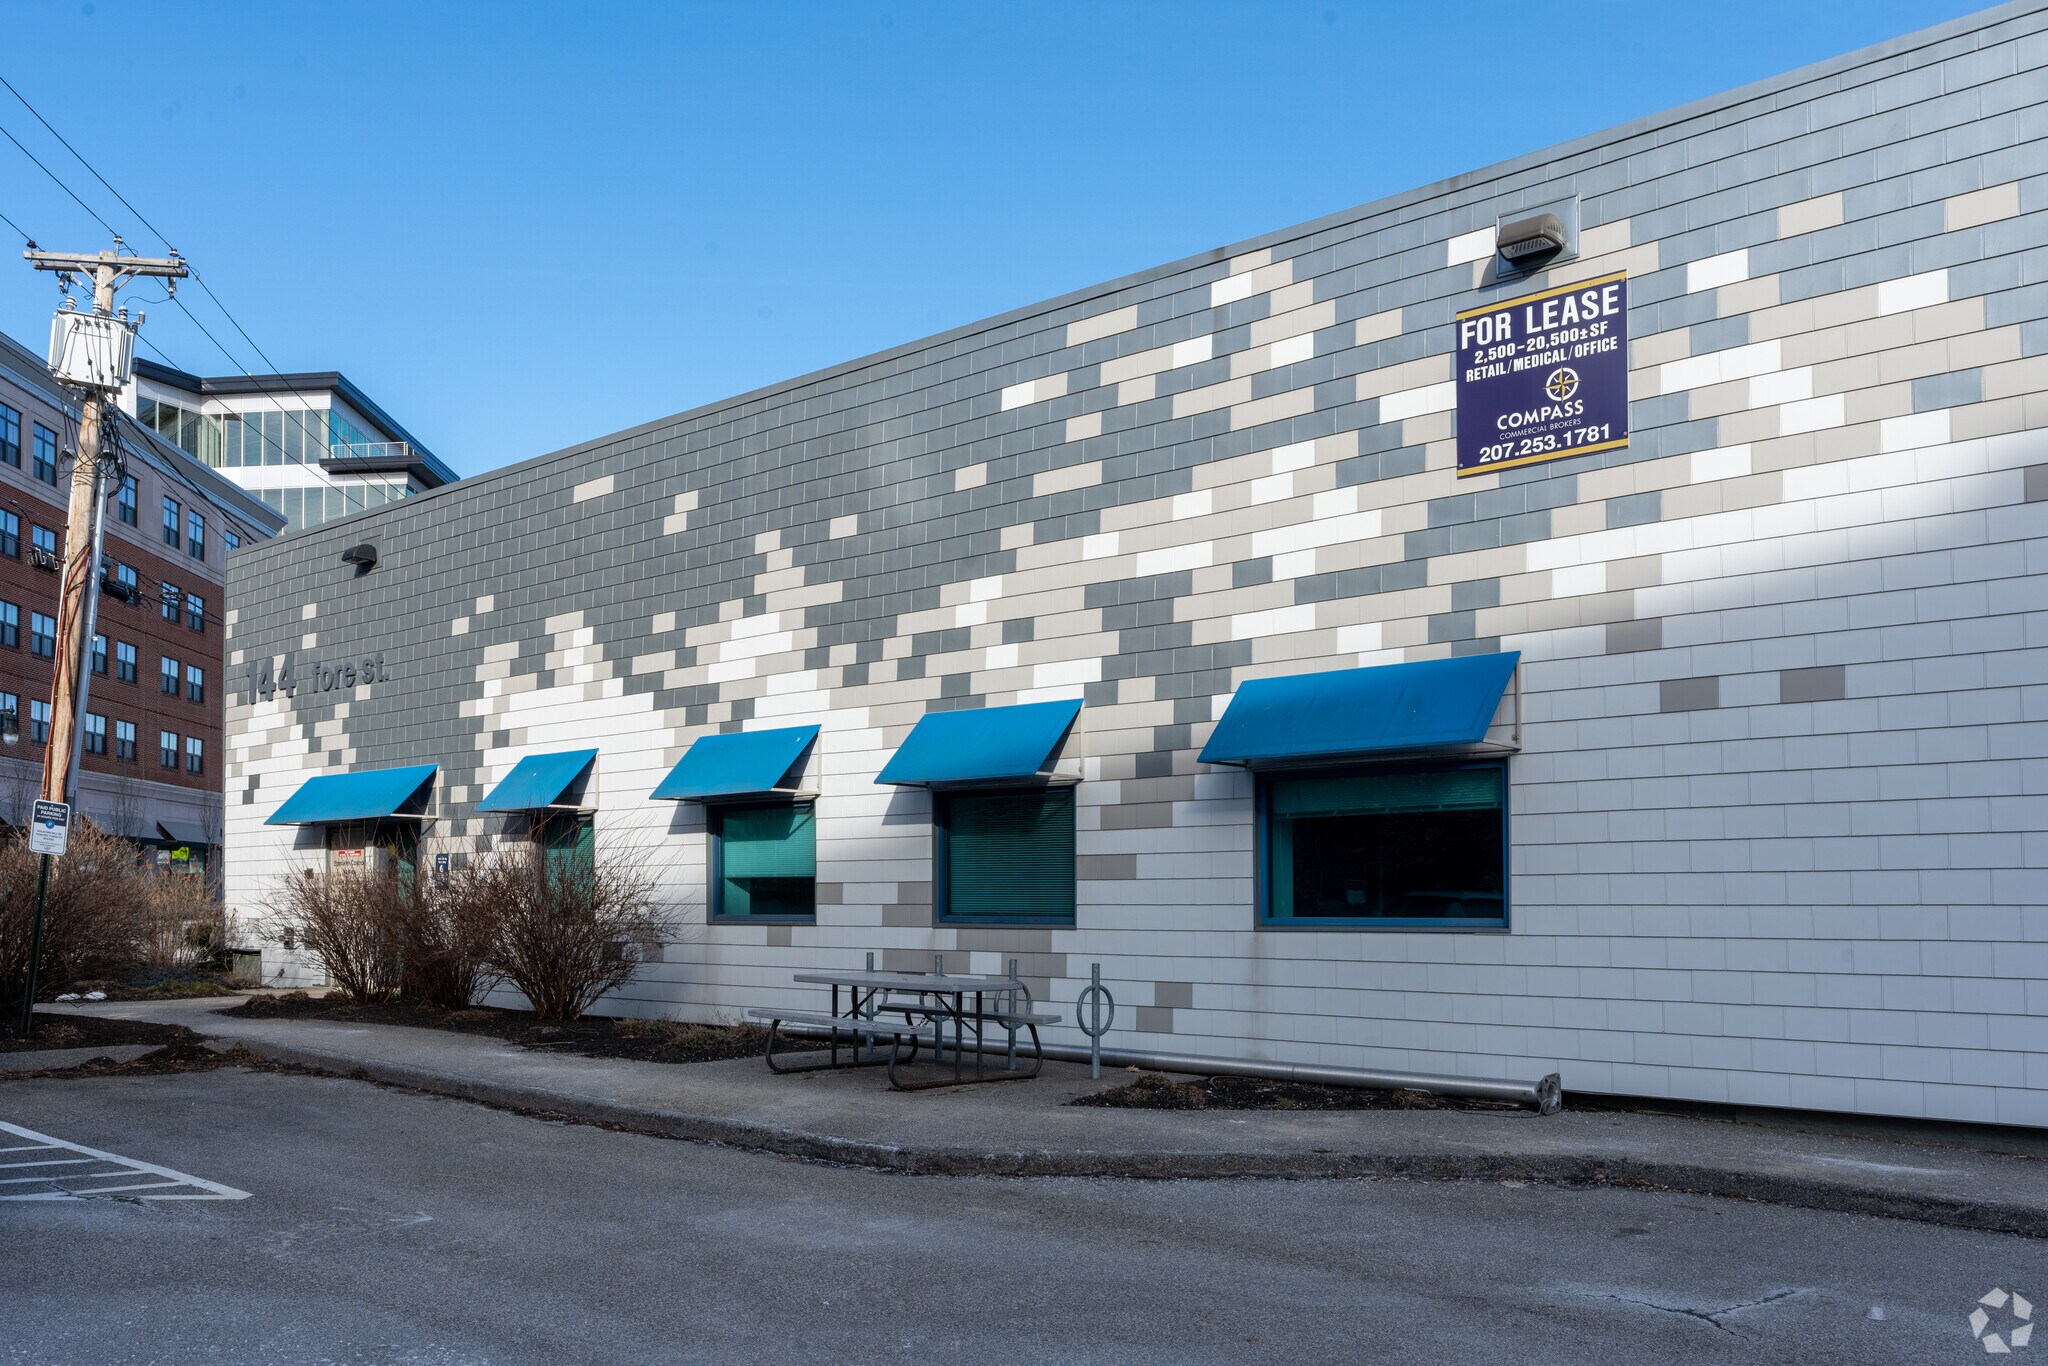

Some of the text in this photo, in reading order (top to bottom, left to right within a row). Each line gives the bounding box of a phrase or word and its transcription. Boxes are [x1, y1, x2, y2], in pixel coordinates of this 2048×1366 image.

[1461, 284, 1620, 350] FOR LEASE
[1466, 336, 1618, 382] RETAIL/MEDICAL/OFFICE
[1496, 399, 1584, 430] COMPASS
[1499, 418, 1582, 441] COMMERCIAL BROKERS
[1479, 423, 1610, 463] 207.253.1781
[246, 652, 297, 705] 144
[439, 864, 444, 873] 6
